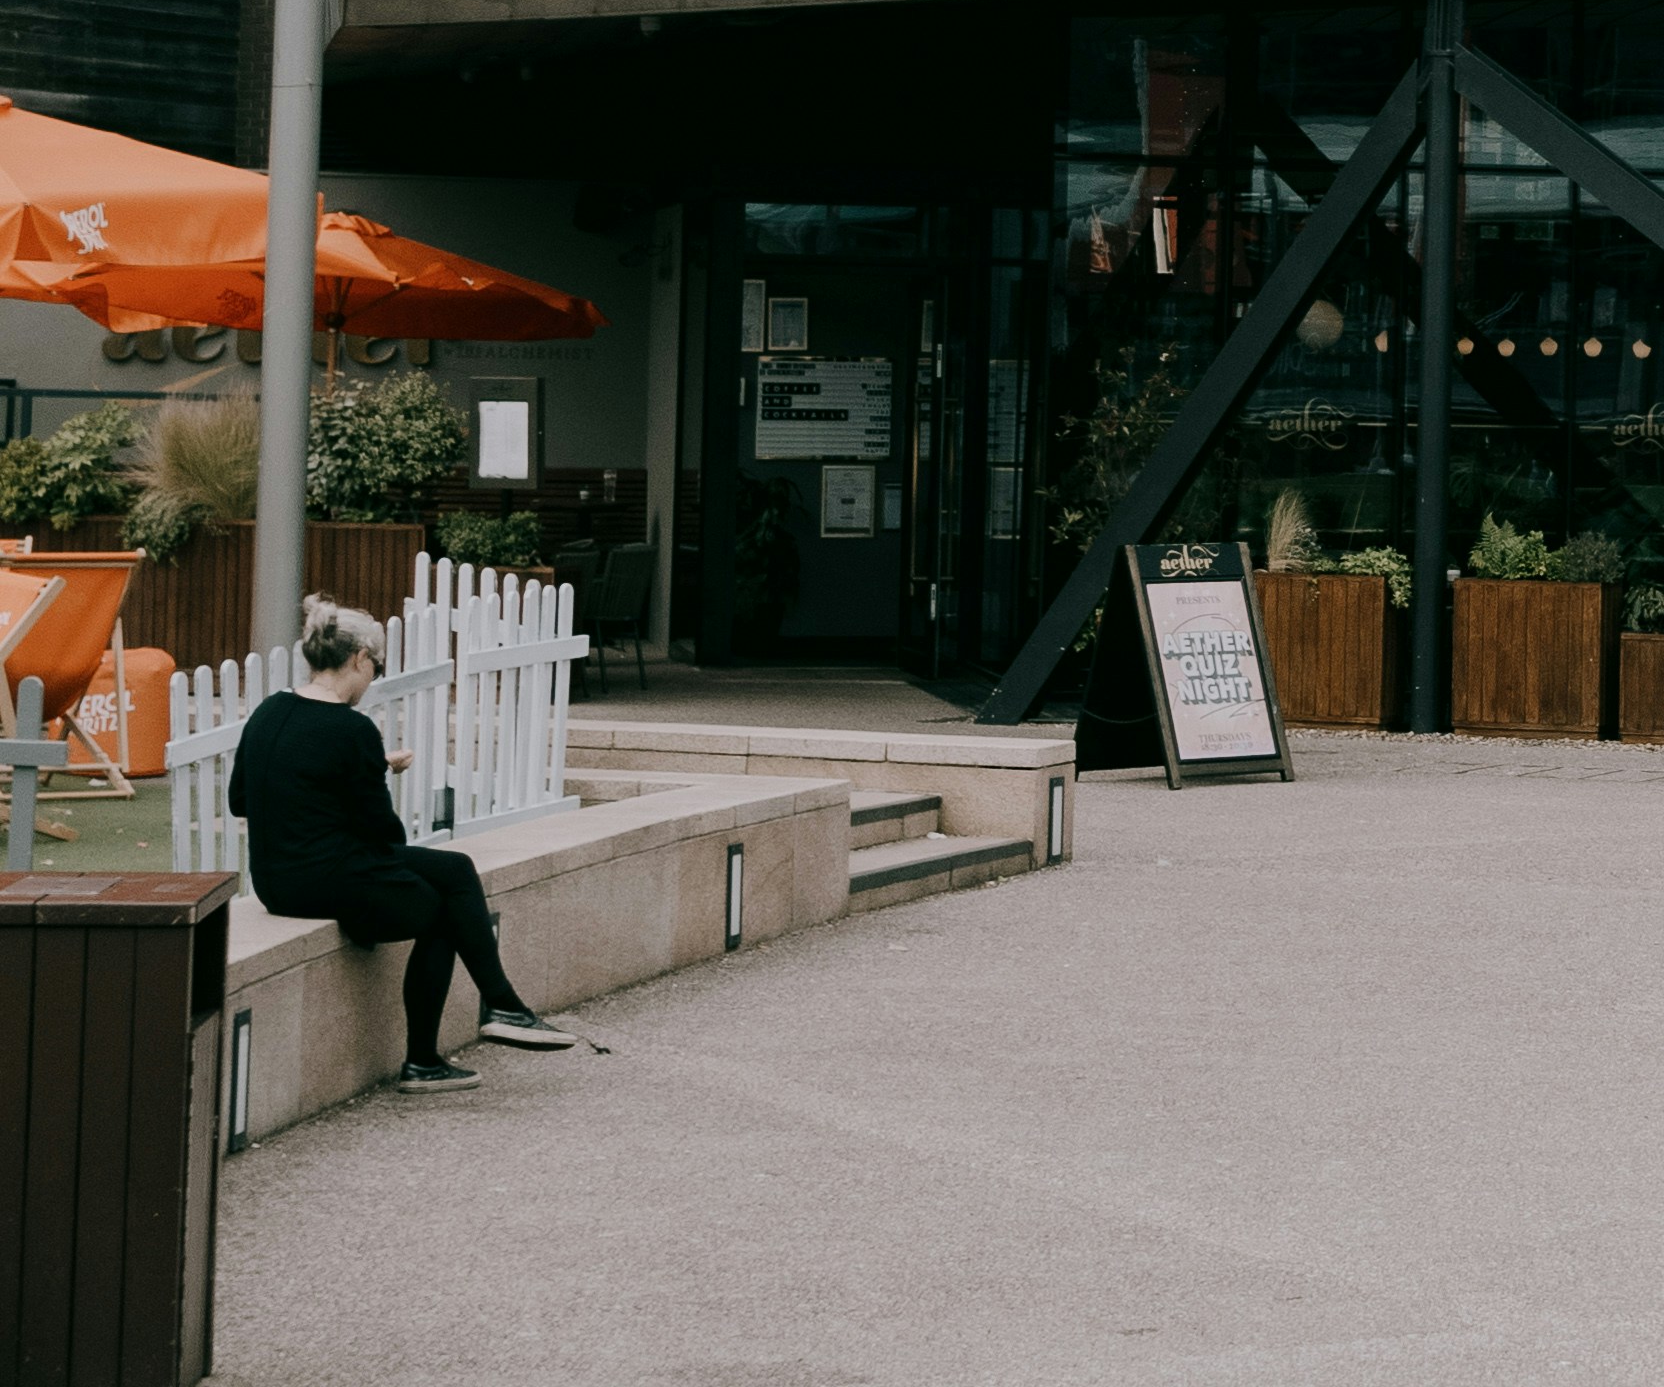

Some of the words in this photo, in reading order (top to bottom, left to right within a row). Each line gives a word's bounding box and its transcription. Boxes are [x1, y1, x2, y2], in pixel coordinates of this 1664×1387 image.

[484, 346, 594, 360] ALCHEMIST
[763, 384, 818, 393] COFFEE
[763, 397, 790, 406] AND
[763, 410, 846, 419] COCKTAILS
[1266, 397, 1347, 439] aether
[1160, 545, 1217, 573] aether
[1175, 595, 1223, 605] PRESENTS
[1163, 630, 1253, 657] AETHER
[1179, 653, 1241, 679] QUIZ
[1177, 677, 1252, 703] NIGHT
[1198, 732, 1252, 743] THURSDAYS
